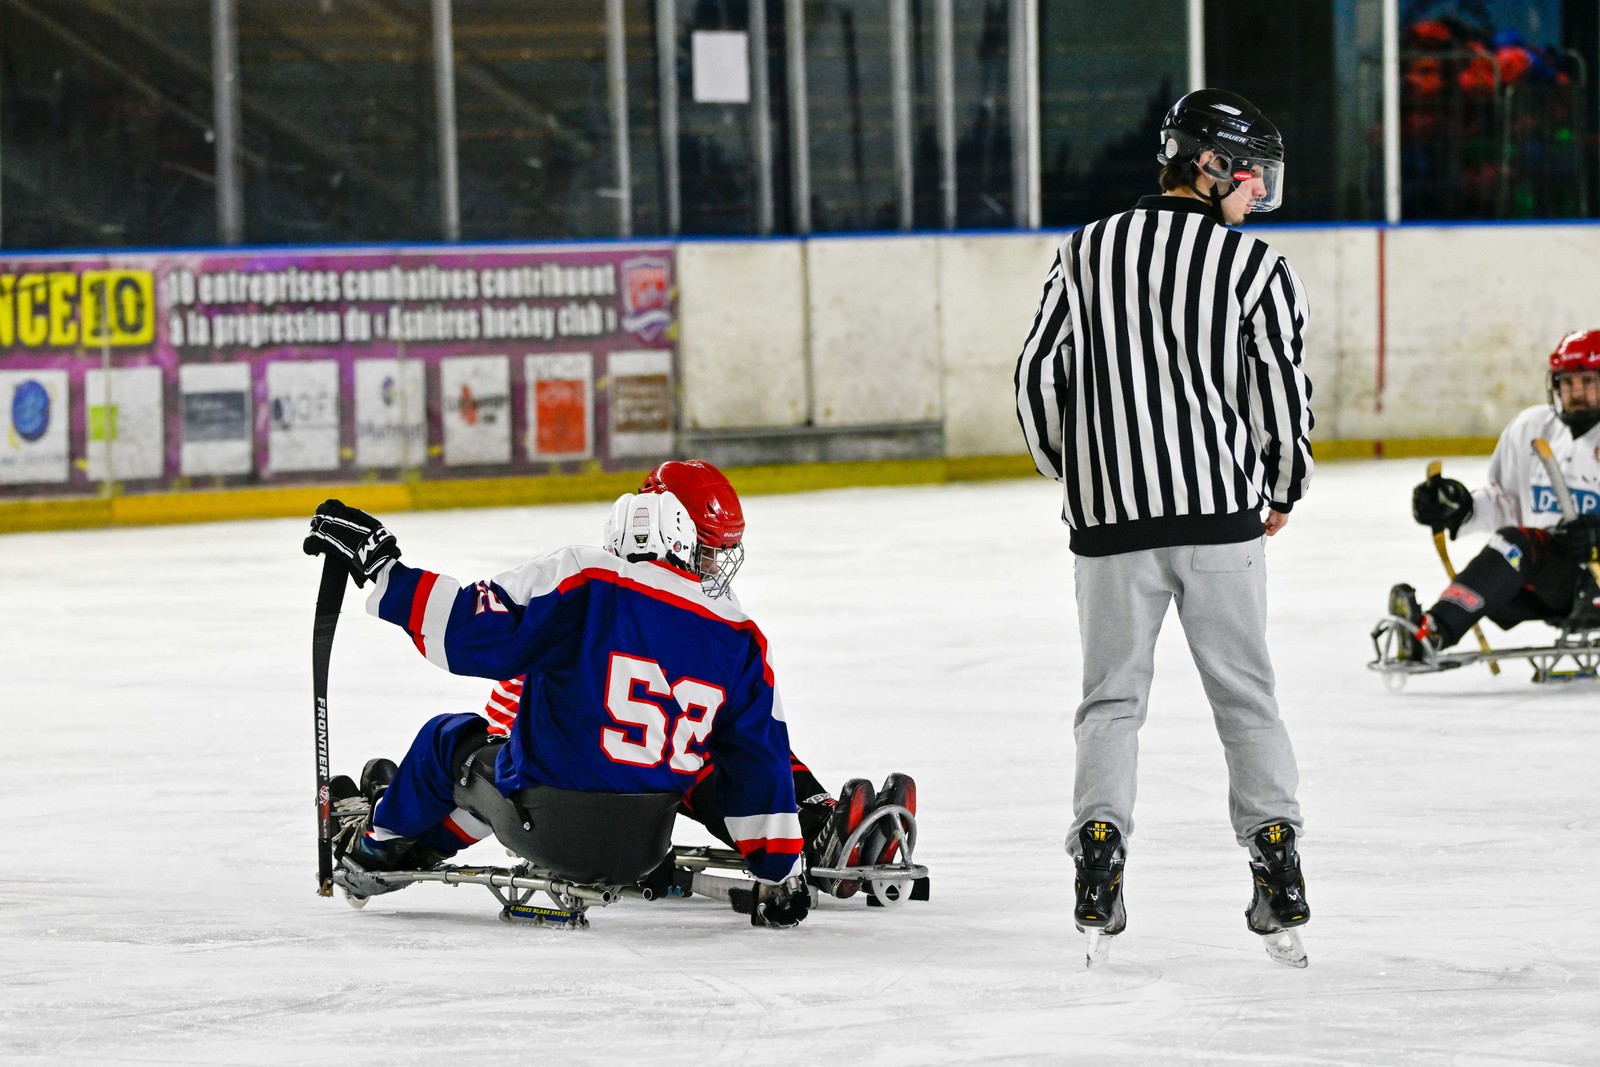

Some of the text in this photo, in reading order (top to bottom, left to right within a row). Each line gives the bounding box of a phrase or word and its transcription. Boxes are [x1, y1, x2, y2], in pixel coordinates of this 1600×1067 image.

[1216, 131, 1247, 143] BAUER
[199, 267, 340, 306] entreprises
[342, 264, 479, 301] combatives
[480, 262, 616, 299] contribuent
[186, 310, 211, 347] la
[212, 308, 341, 348] progression
[343, 306, 371, 341] du
[481, 303, 556, 340] hockey
[557, 301, 603, 337] club
[317, 696, 328, 777] FRONTIER
[601, 651, 727, 775] 52
